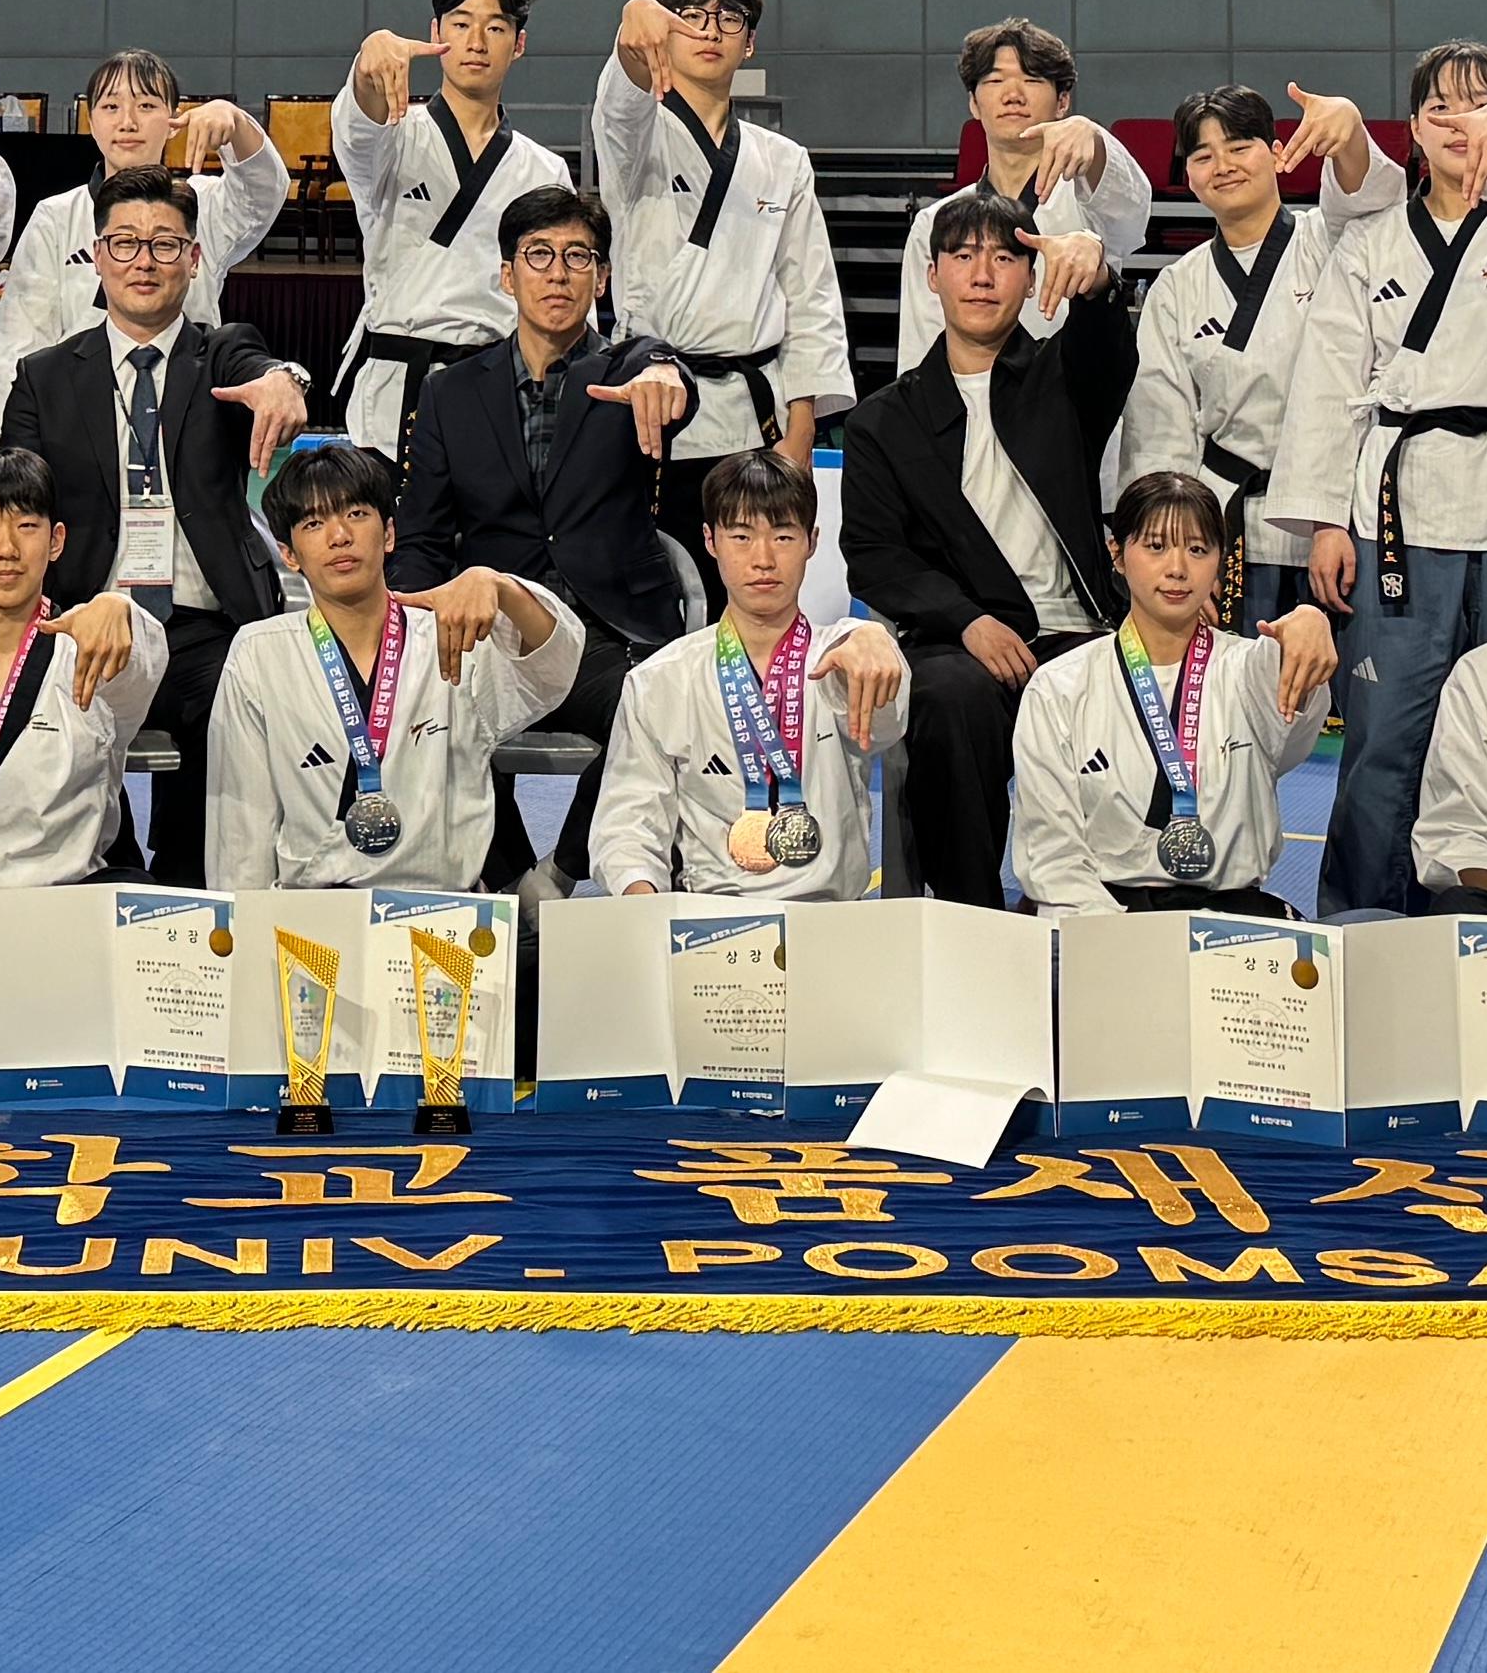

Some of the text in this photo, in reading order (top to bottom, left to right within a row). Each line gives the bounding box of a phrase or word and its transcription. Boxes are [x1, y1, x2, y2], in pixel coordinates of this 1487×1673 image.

[327, 664, 360, 727] 신한대학교
[373, 665, 395, 729] 신한대학교
[724, 680, 750, 744] 신한대학교
[739, 680, 776, 743] 신한대학교
[783, 674, 801, 739] 신한대학교
[1142, 690, 1174, 753] 신한대학교
[1183, 688, 1200, 750] 신한대학교
[351, 734, 373, 767] 제5회
[741, 751, 761, 784] 제5회
[769, 748, 793, 781] 제5회
[1167, 759, 1188, 793] 제5회
